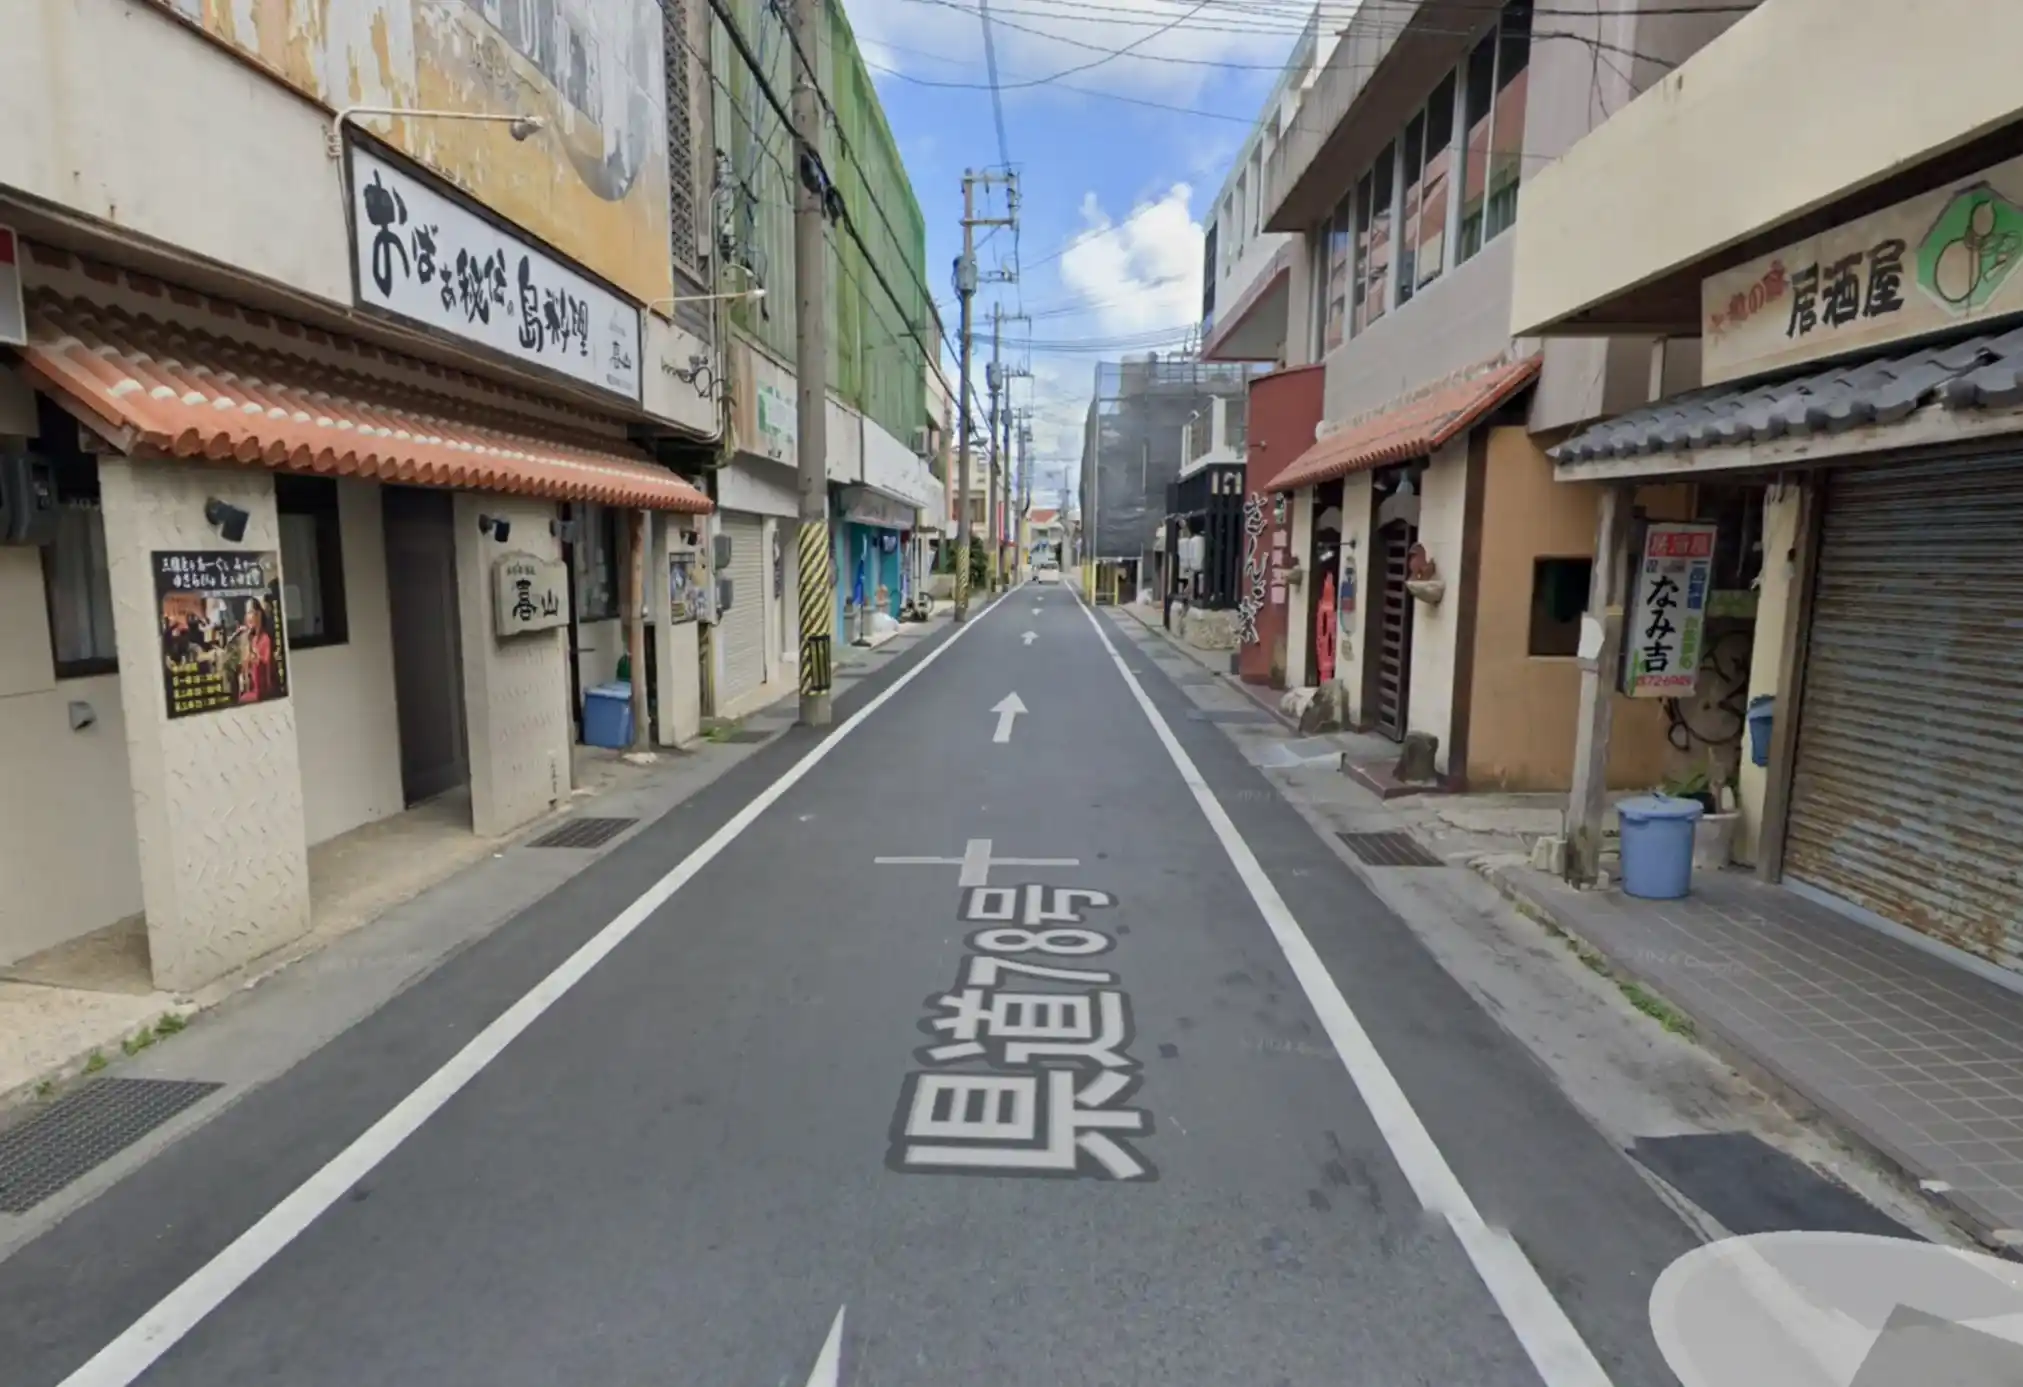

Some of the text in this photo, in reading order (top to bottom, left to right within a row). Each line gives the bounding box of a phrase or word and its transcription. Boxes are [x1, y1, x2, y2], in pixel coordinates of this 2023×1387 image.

[1786, 238, 1907, 339] 居酒屋
[1643, 575, 1679, 673] なみ吉
